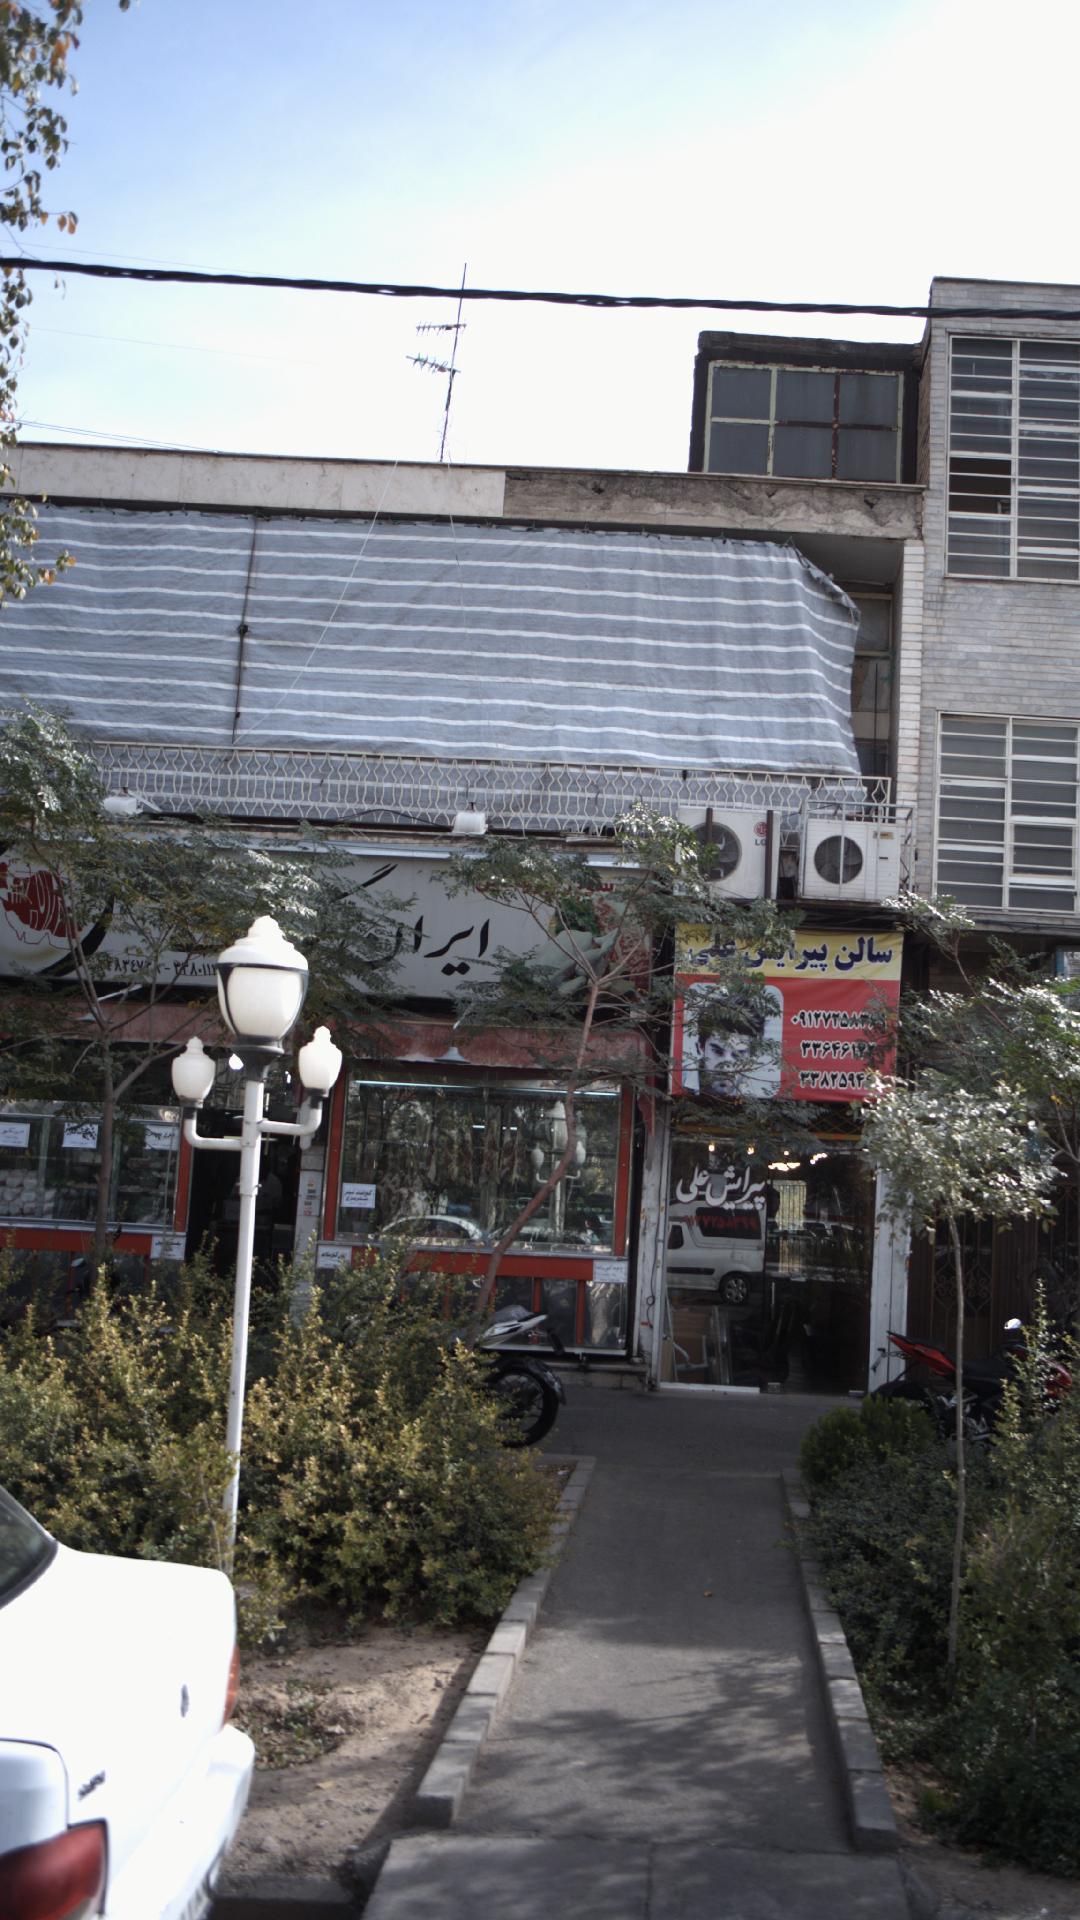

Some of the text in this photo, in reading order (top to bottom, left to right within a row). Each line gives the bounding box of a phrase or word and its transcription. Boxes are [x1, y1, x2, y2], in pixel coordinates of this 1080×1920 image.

[835, 936, 893, 971] سالن
[675, 1164, 766, 1210] پیرایش علی
